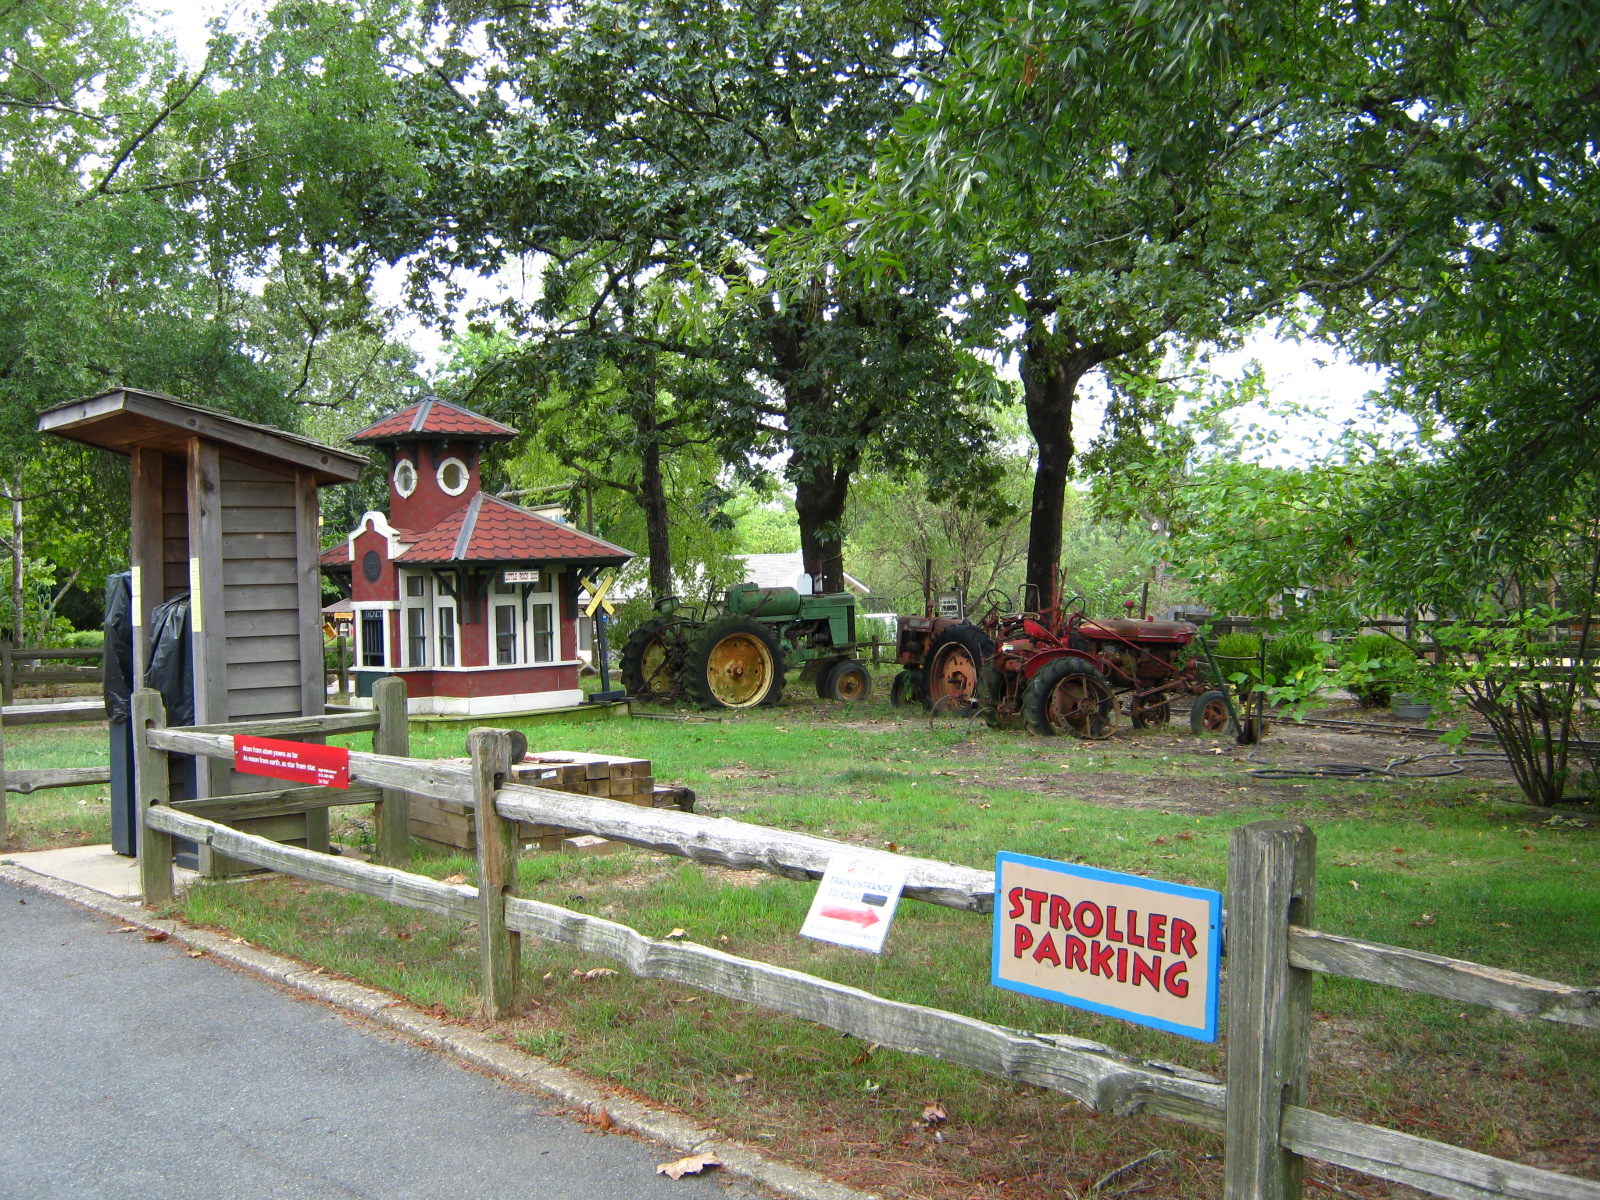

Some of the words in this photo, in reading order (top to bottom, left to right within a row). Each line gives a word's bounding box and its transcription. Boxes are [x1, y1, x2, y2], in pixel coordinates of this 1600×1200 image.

[829, 888, 838, 896] TO
[840, 891, 860, 901] YOUR
[830, 876, 852, 886] TRAIN
[852, 880, 893, 894] ENTRANCE
[1008, 886, 1198, 959] STROLLER
[1013, 923, 1190, 998] PARKING
